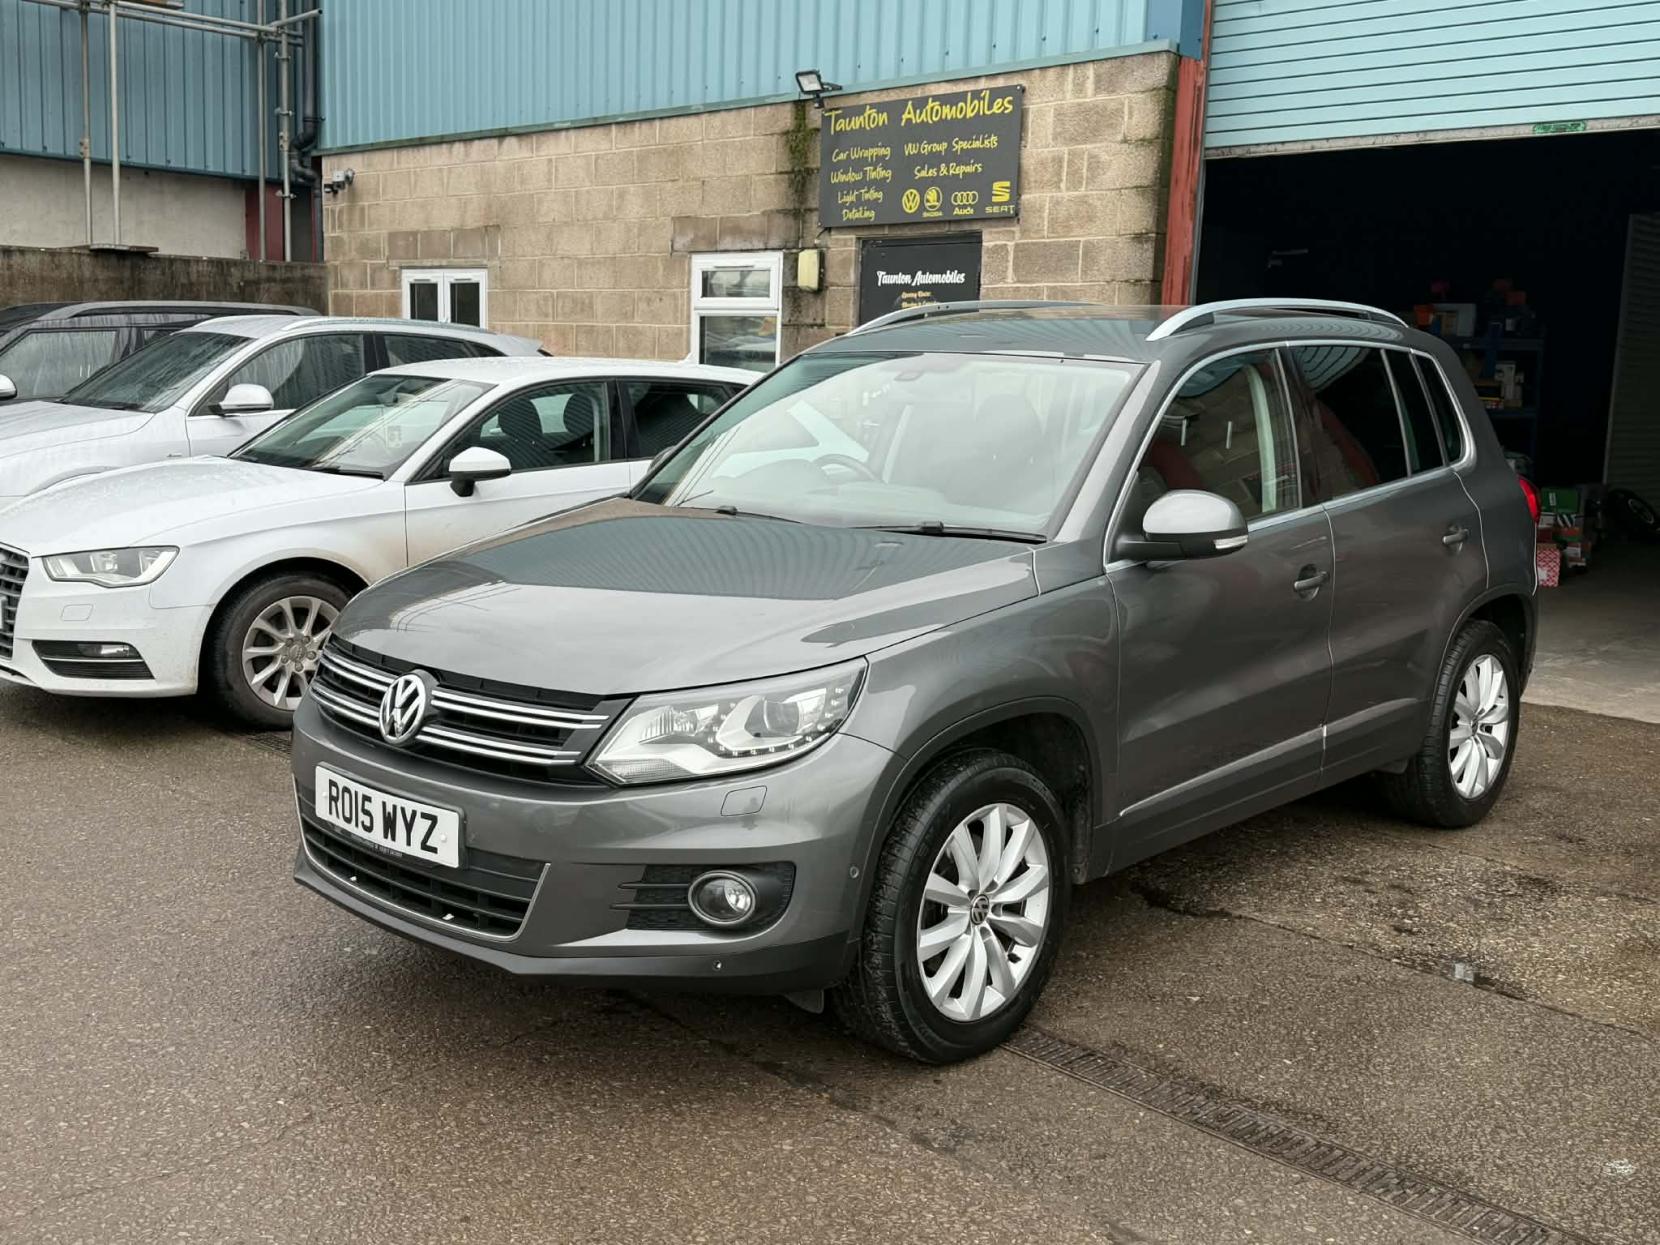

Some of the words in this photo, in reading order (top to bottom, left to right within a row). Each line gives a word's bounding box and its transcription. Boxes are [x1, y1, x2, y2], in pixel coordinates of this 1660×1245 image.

[824, 105, 888, 135] Taunton
[901, 90, 1013, 126] Automobiles
[832, 148, 849, 162] Car
[850, 142, 891, 163] Wrapping
[904, 143, 919, 156] VW
[920, 141, 948, 155] Group
[952, 134, 998, 155] Specialists
[831, 167, 863, 184] Window
[864, 163, 892, 182] Tinting
[914, 164, 937, 179] Sales
[939, 163, 948, 176] &
[949, 160, 982, 178] Repairs
[838, 189, 859, 206] Light
[859, 186, 883, 203] Tinting
[842, 206, 875, 221] Detailing
[953, 207, 974, 216] Audi
[985, 205, 1015, 214] SEAT
[876, 270, 912, 287] Taunton
[911, 269, 966, 287] Automobiles
[328, 778, 374, 834] RO15
[381, 800, 438, 855] WYZ
